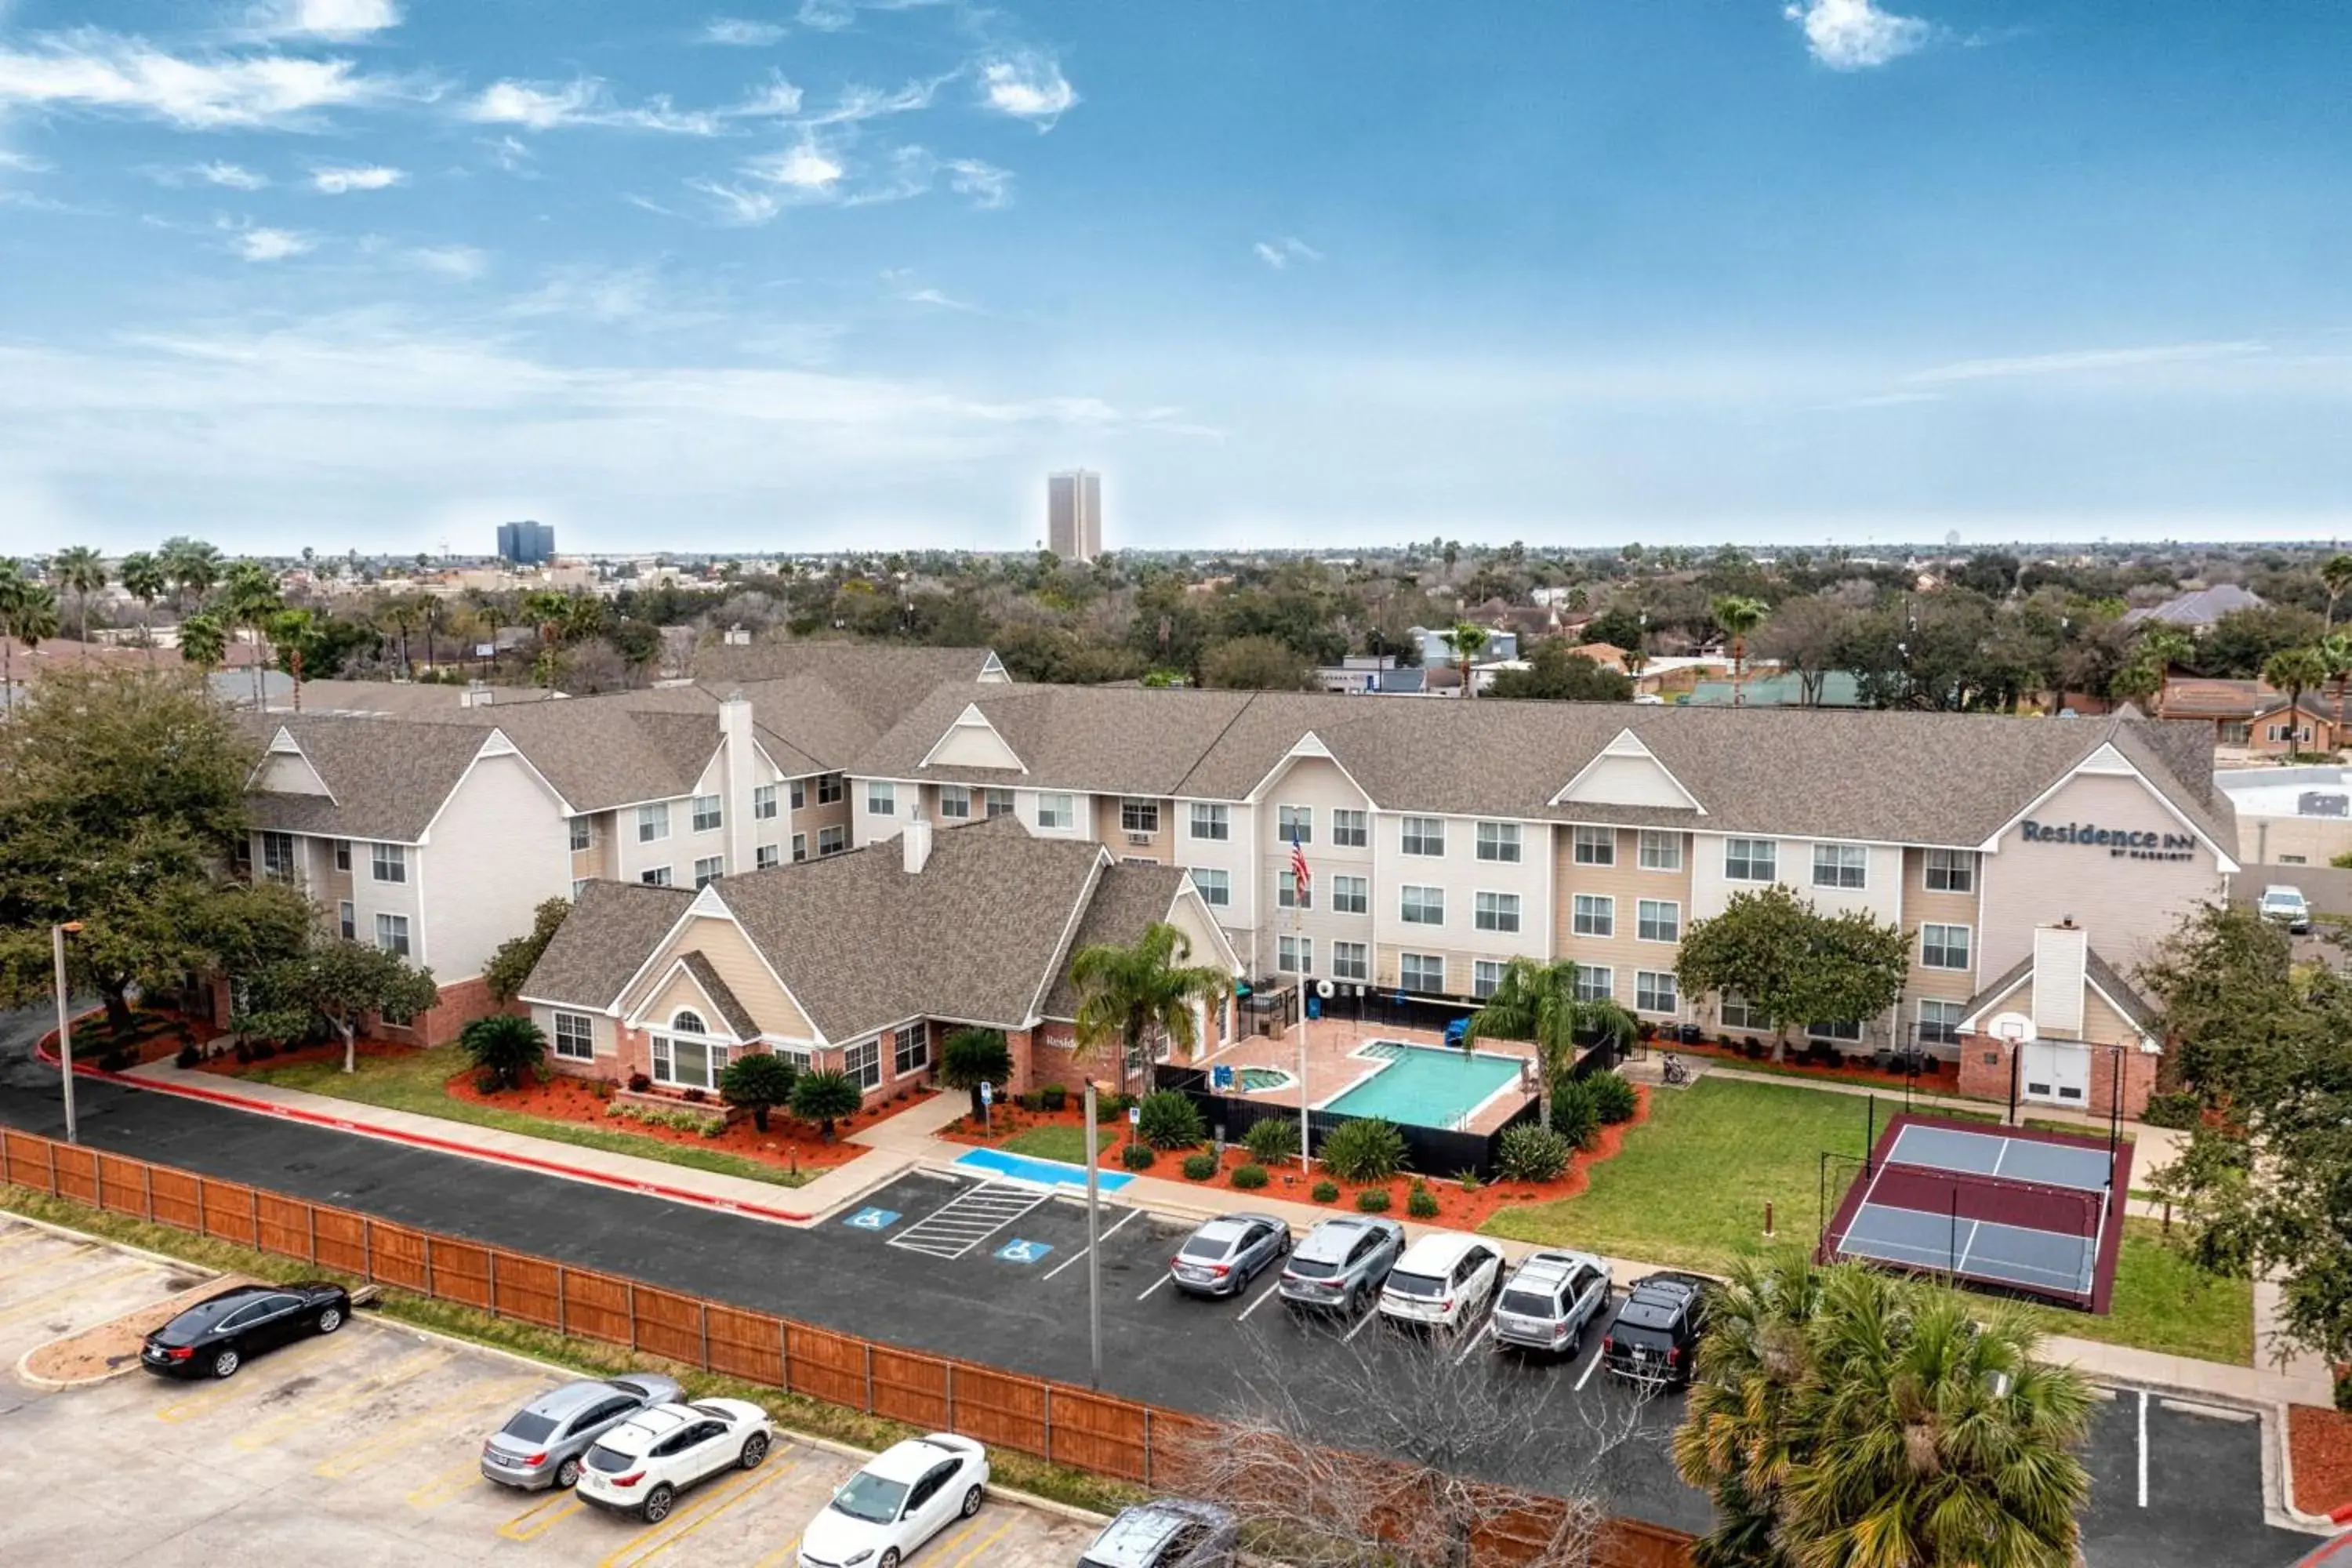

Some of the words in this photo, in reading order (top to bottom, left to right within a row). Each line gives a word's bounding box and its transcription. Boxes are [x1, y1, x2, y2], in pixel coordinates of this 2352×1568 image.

[2021, 819, 2158, 848] Residence
[2163, 833, 2196, 850] INN
[2111, 849, 2126, 858] BY
[2130, 850, 2194, 862] MARRIOTT
